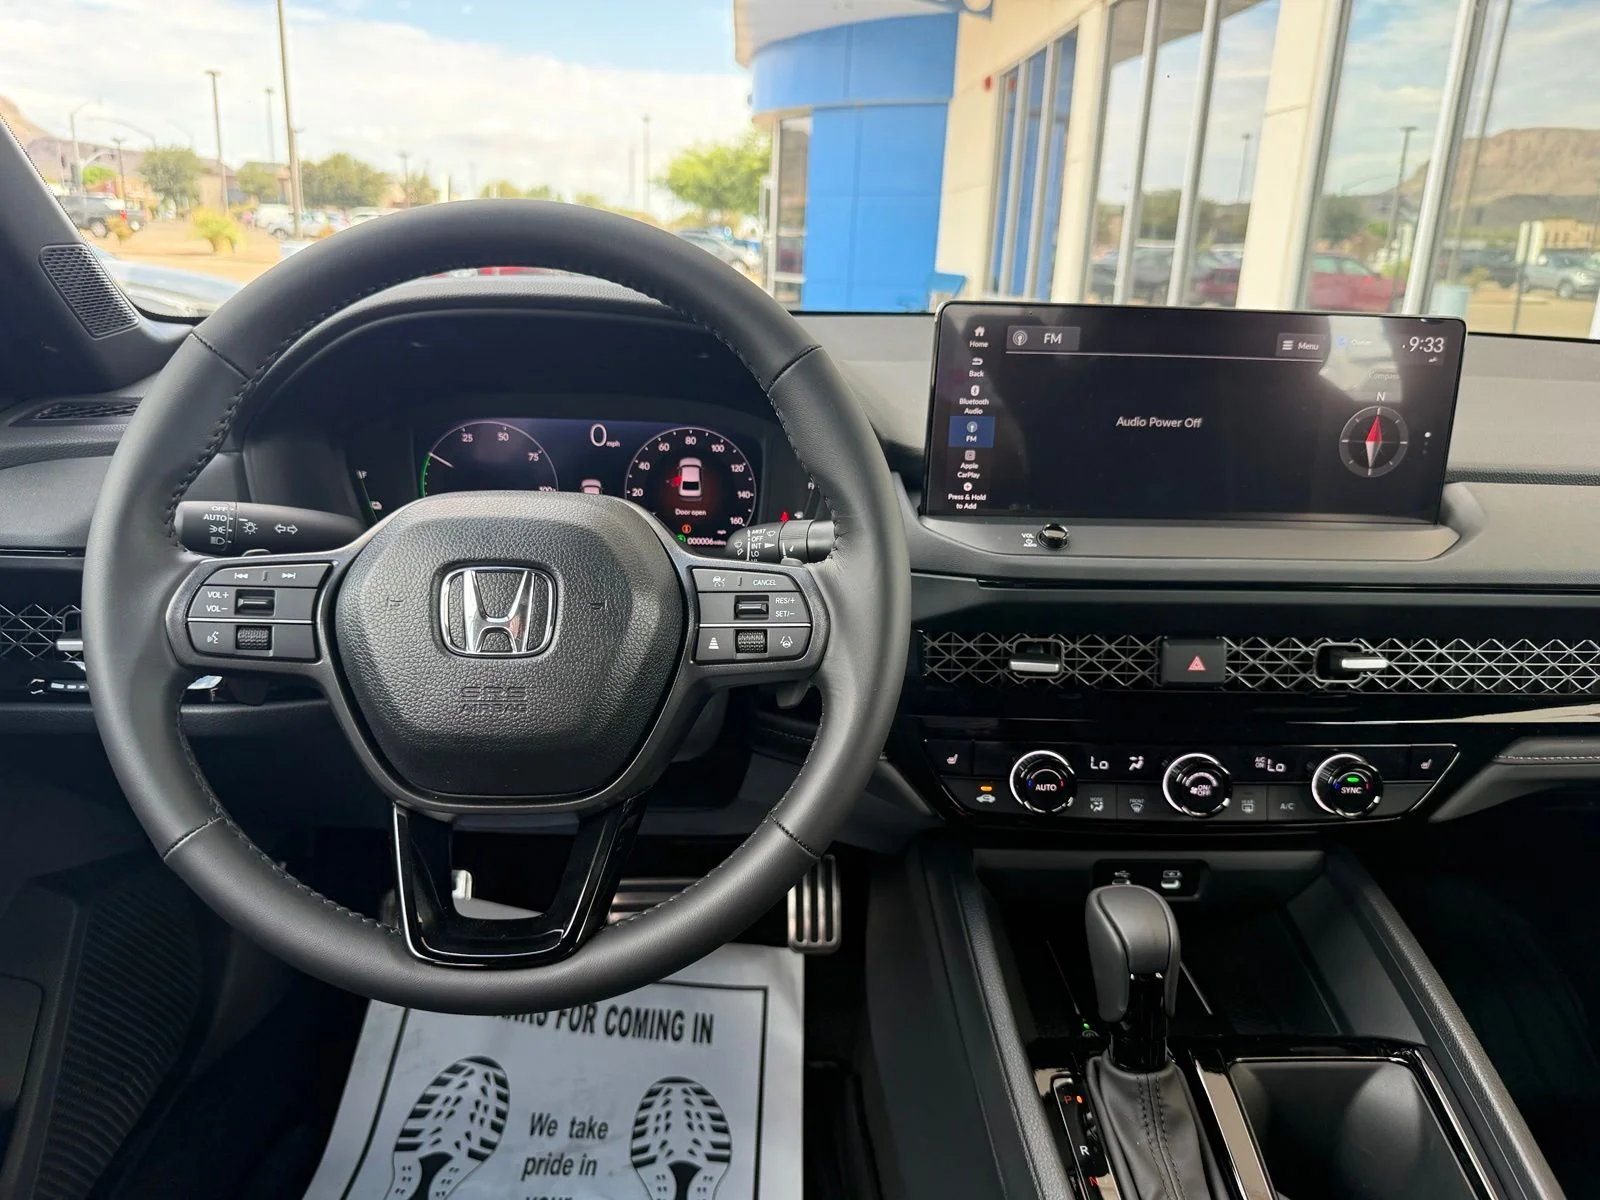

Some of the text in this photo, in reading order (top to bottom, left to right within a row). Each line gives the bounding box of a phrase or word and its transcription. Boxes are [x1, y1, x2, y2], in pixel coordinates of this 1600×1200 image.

[1043, 332, 1062, 344] FM
[969, 340, 989, 348] Home
[1298, 342, 1319, 351] Menu
[1409, 336, 1444, 353] 9:33
[968, 370, 984, 378] Back
[1376, 391, 1386, 401] N
[959, 397, 989, 406] Bluetooth
[963, 407, 984, 416] Audio
[1116, 416, 1203, 428] Audio Power Off
[461, 433, 473, 443] 25
[497, 433, 509, 442] 50
[590, 423, 607, 447] 0
[965, 435, 978, 443] FM
[685, 436, 696, 446] 80
[658, 443, 670, 452] 60
[711, 444, 725, 453] 100
[528, 452, 540, 462] 75
[638, 462, 650, 471] 40
[730, 464, 744, 473] 120
[960, 462, 979, 470] Apple
[957, 471, 981, 479] CarPlay
[631, 488, 643, 497] 20
[737, 490, 751, 499] 140
[947, 493, 965, 501] Press
[956, 502, 963, 510] to
[674, 508, 691, 516] Door
[202, 513, 227, 522] AUTO
[729, 517, 744, 525] 160
[750, 542, 763, 550] INT
[1090, 756, 1110, 770] Lo
[1035, 783, 1057, 792] AUTO
[1340, 786, 1362, 795] SYNC
[555, 1003, 598, 1034] FOR
[604, 1004, 686, 1043] COMING
[692, 1012, 714, 1044] IN
[1064, 1095, 1072, 1104] P
[530, 1112, 608, 1140] We take
[1079, 1145, 1090, 1156] R
[521, 1151, 597, 1181] pride in
